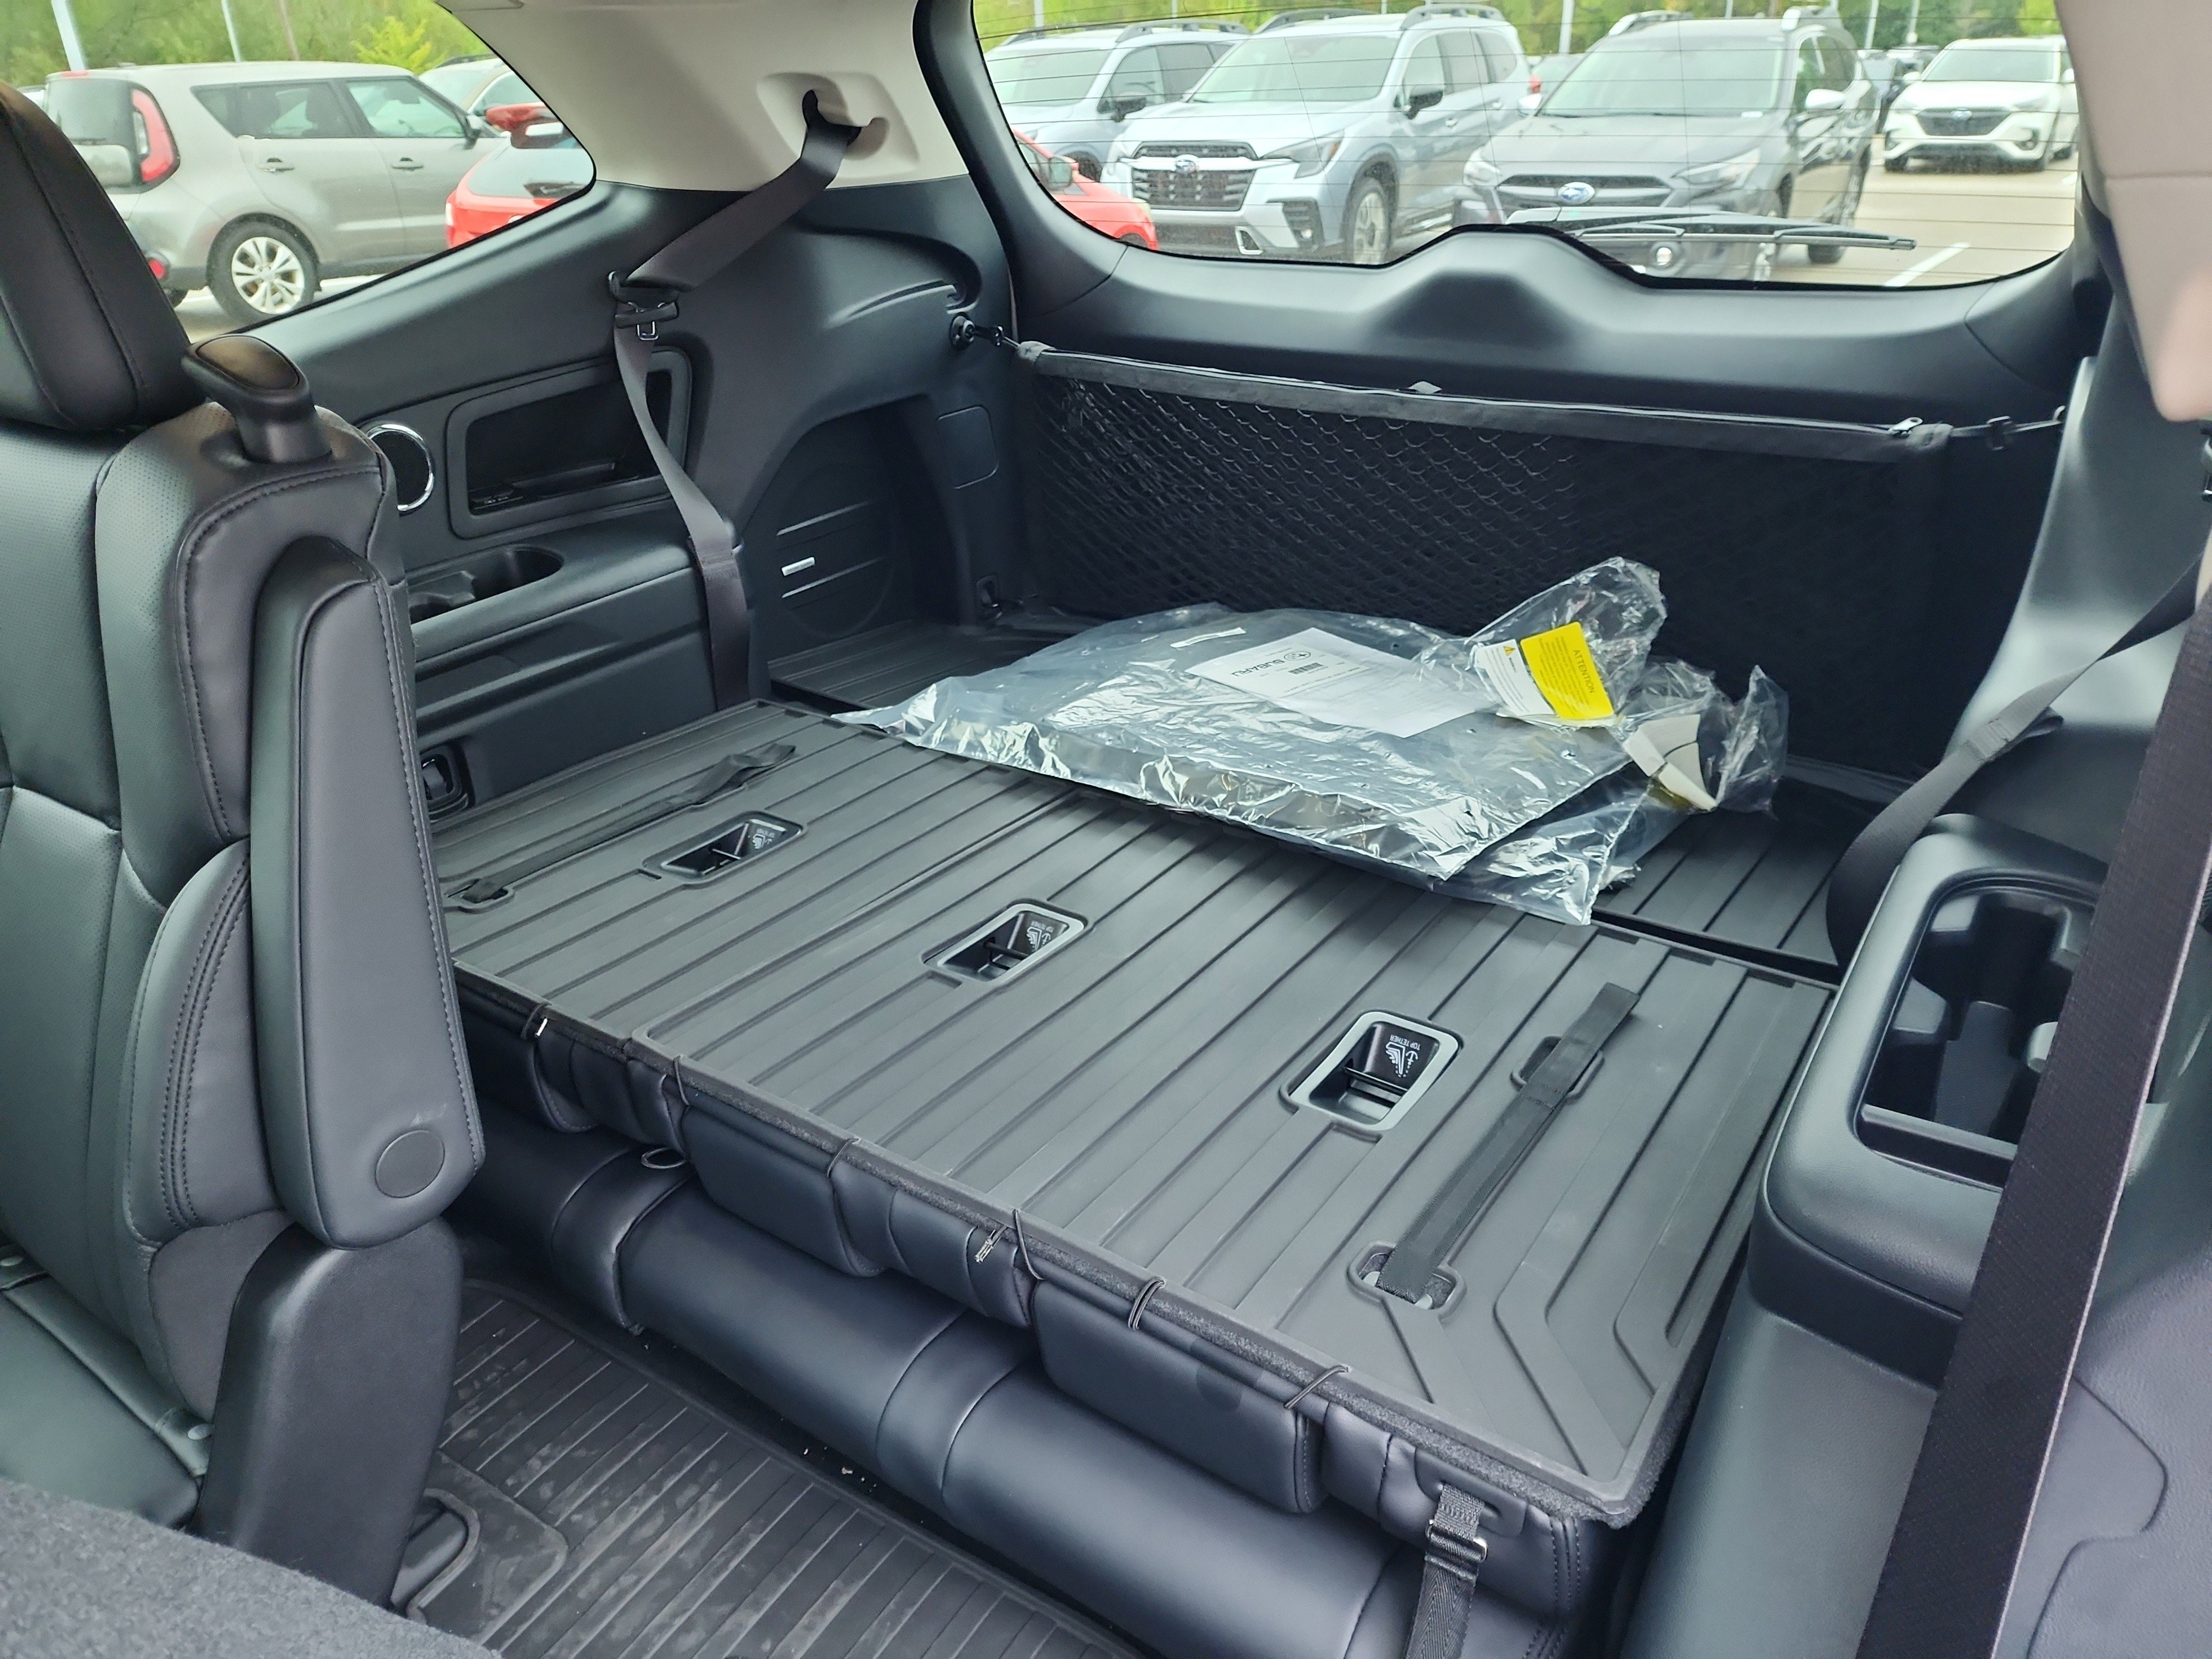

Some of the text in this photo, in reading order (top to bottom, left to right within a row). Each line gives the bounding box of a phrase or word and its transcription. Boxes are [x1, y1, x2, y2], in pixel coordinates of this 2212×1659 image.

[1231, 659, 1285, 677] SUBARU
[1573, 649, 1596, 693] ATTENTION
[1390, 1034, 1421, 1051] TOP TETHER
